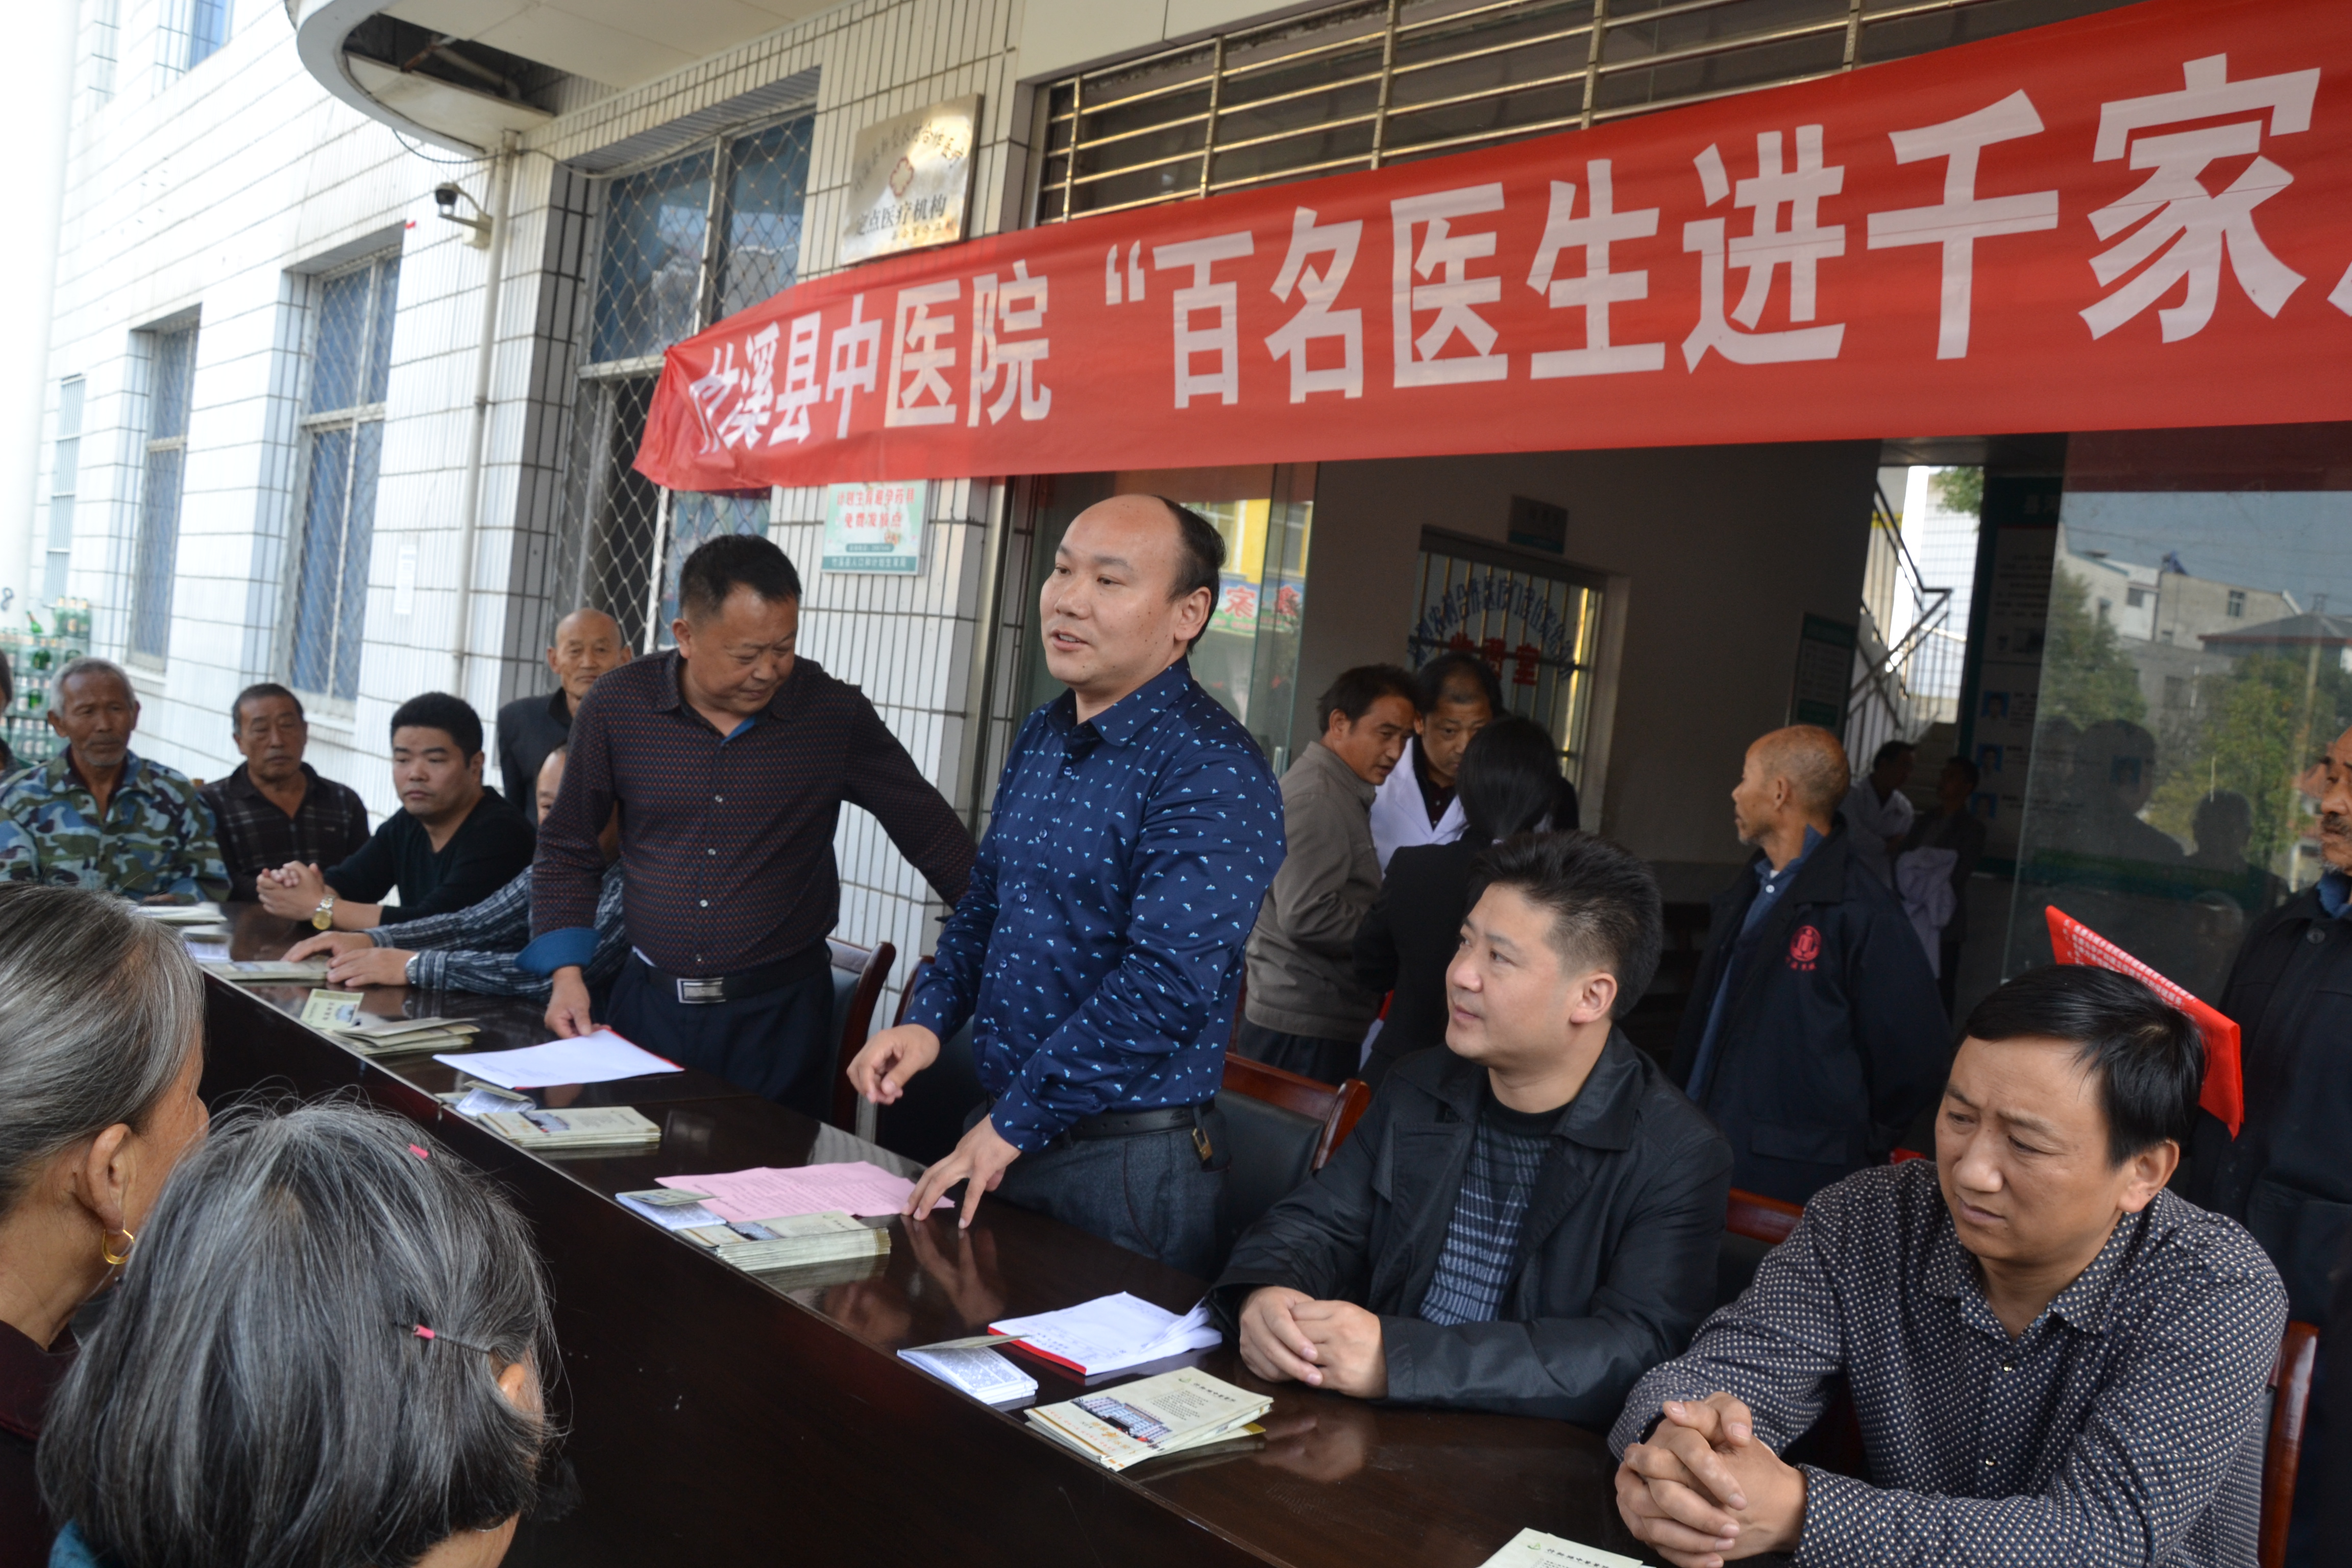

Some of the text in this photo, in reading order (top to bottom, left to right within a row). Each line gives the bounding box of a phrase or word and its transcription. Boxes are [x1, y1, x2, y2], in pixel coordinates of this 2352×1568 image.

[855, 193, 947, 236] 定点医疗机构
[837, 487, 915, 506] 计划生育避孕药具
[845, 511, 902, 528] 免费发放点
